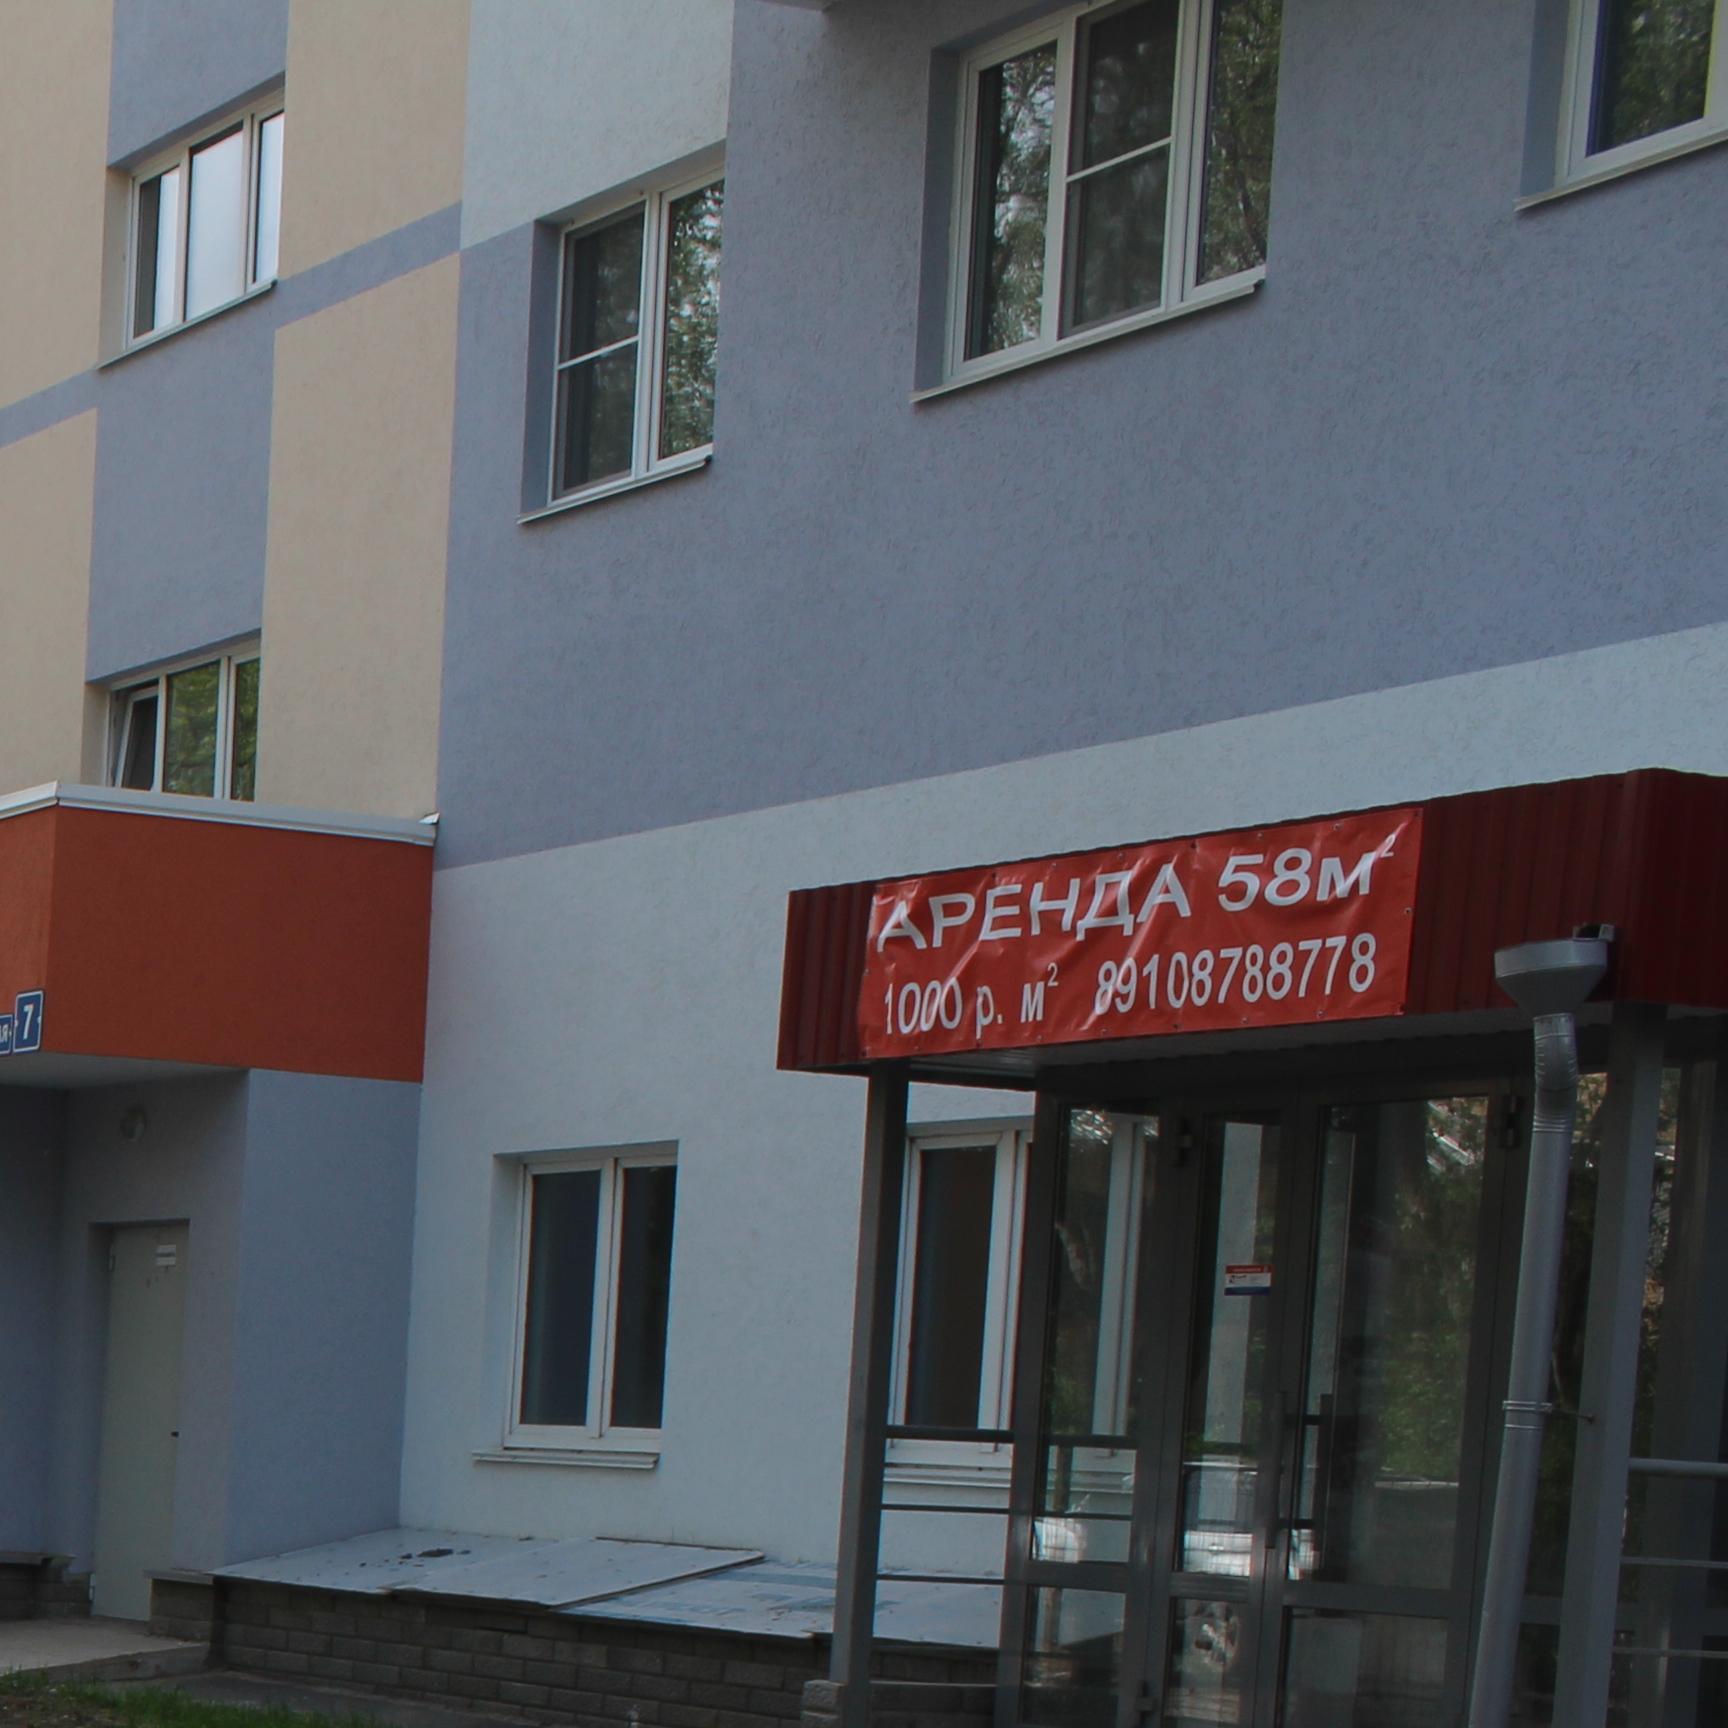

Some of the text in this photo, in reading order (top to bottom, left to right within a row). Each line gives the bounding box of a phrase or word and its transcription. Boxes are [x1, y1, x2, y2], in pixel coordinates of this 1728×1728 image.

[877, 864, 1192, 953] АРЕНДА
[22, 1003, 34, 1040] 7
[884, 980, 963, 1036] 1000
[1093, 932, 1376, 1017] 89108788778
